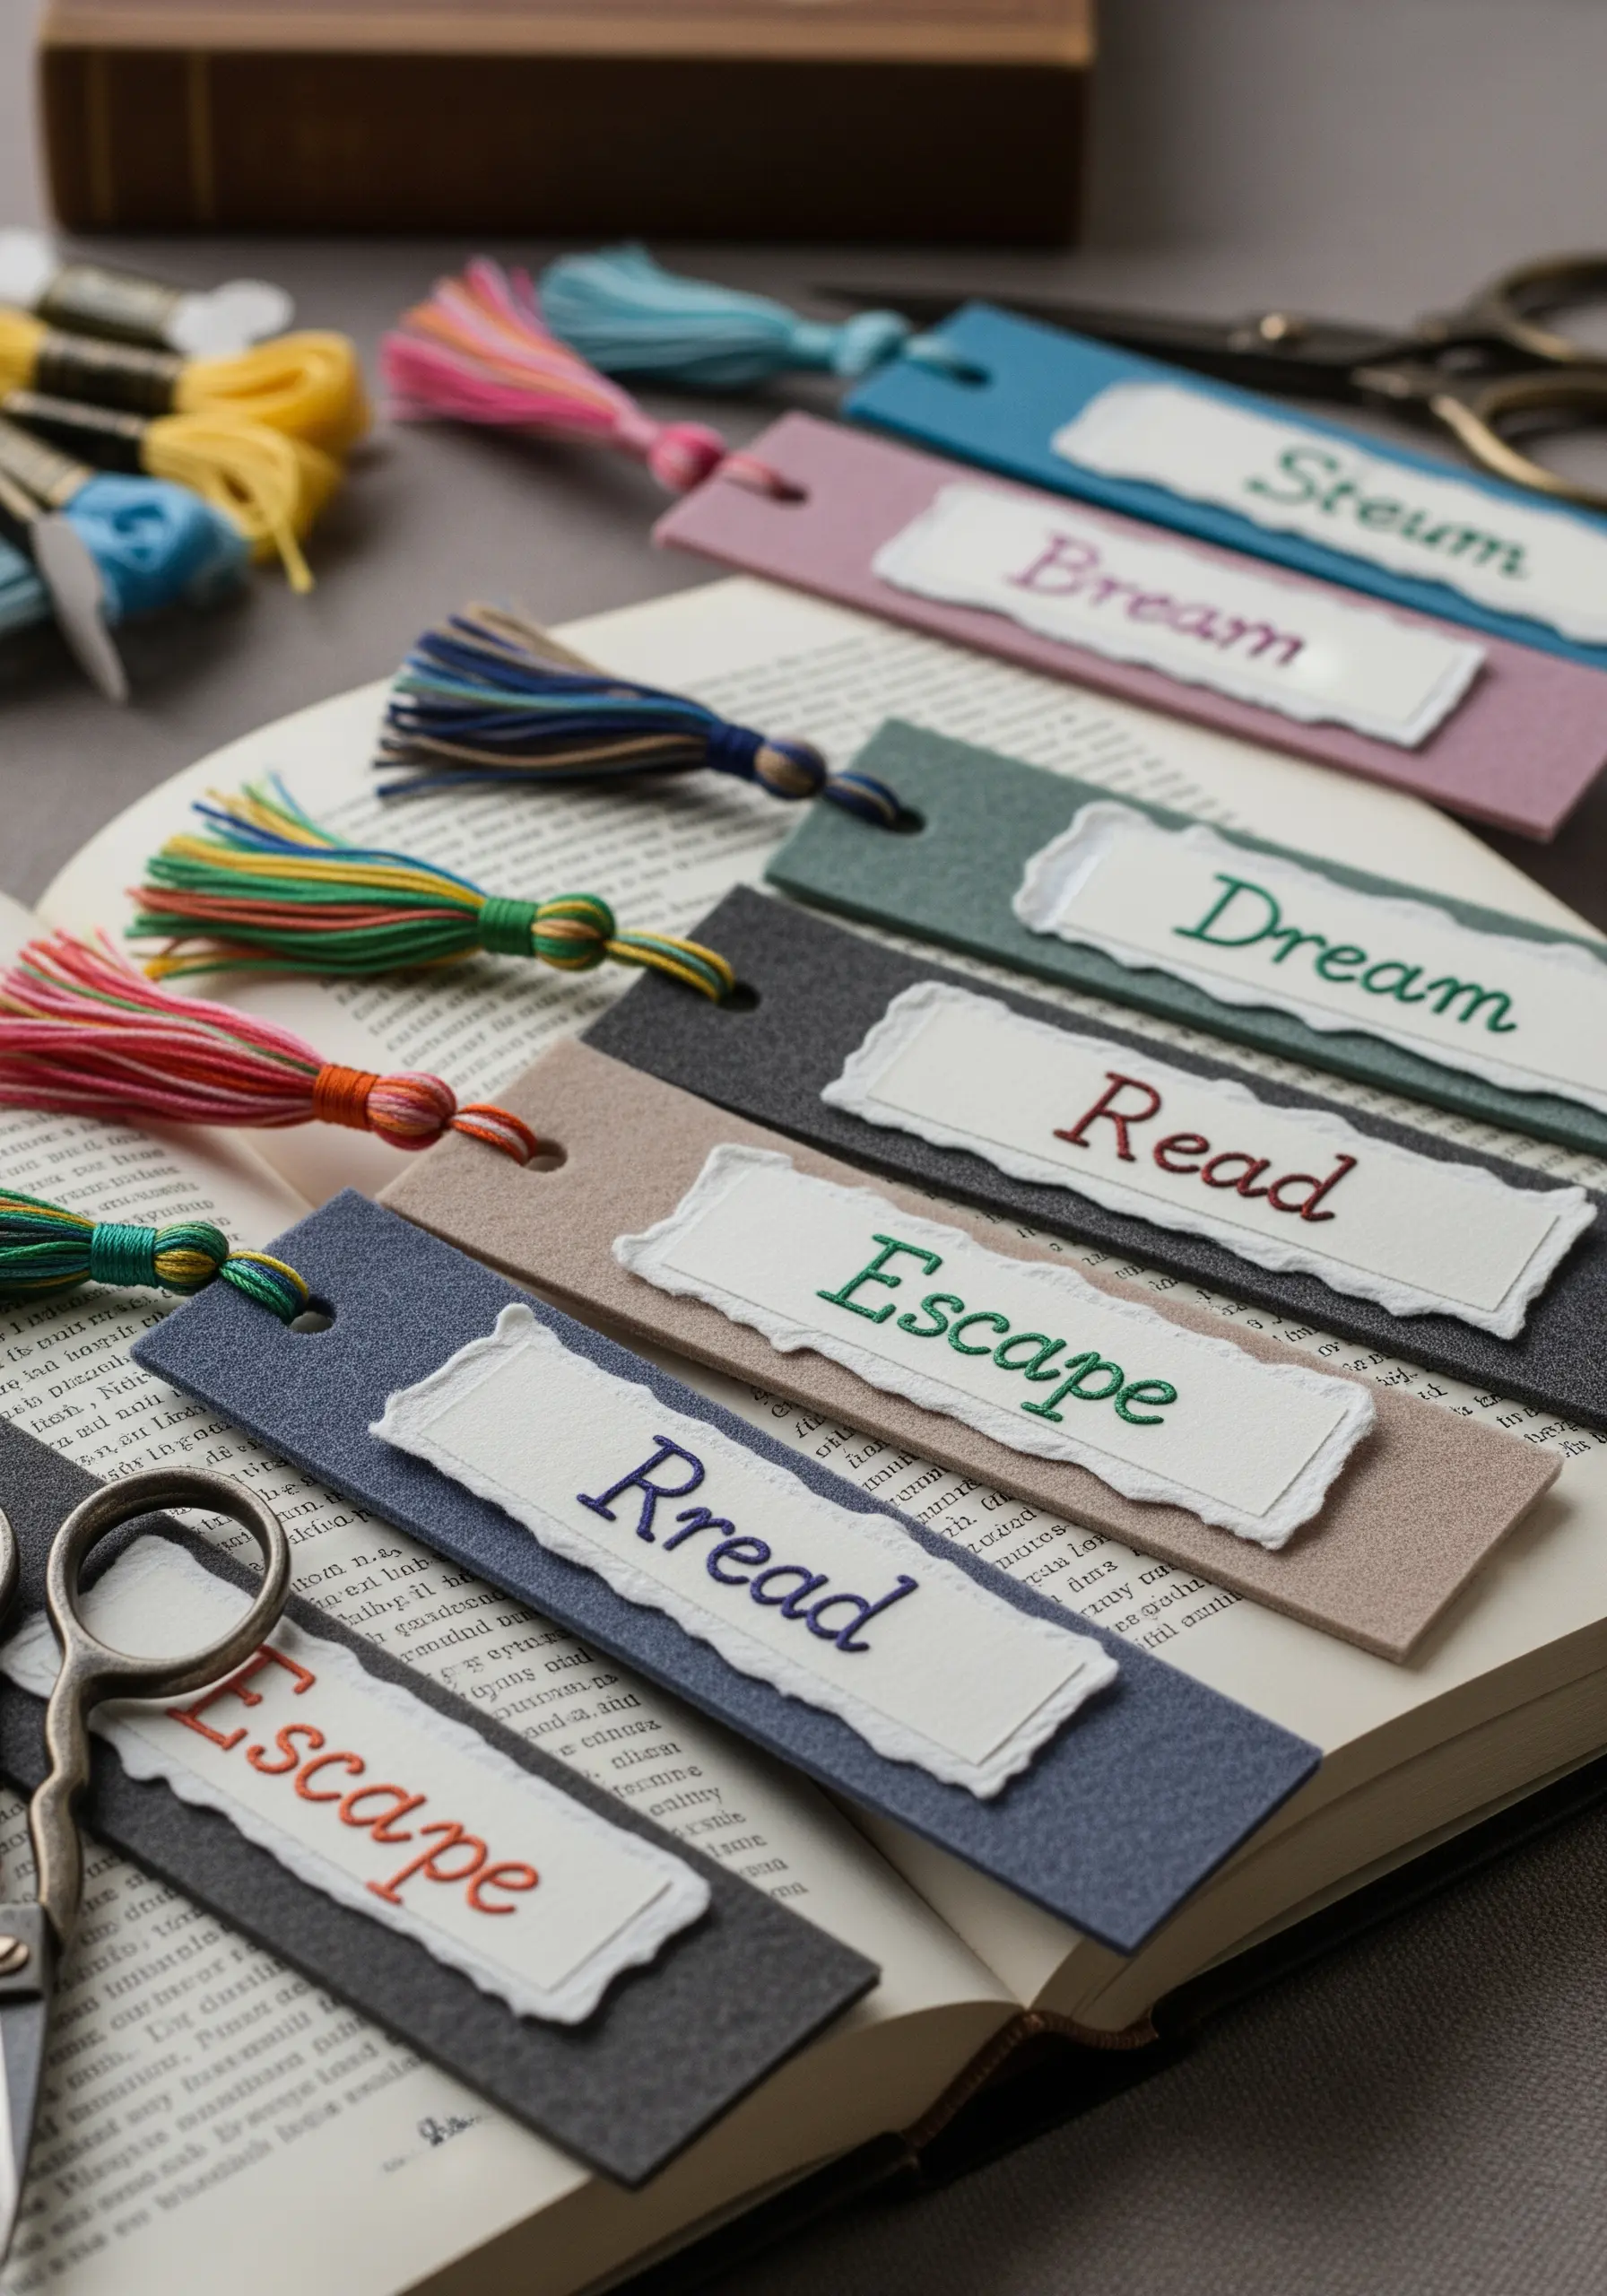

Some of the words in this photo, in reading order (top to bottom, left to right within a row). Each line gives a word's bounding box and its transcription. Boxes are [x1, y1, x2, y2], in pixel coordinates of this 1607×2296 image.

[1006, 527, 1305, 667] Bream
[1174, 874, 1518, 1034] Dream
[1054, 1071, 1358, 1222] Read
[815, 1232, 1178, 1426] Escape
[576, 1434, 919, 1651] Rread
[167, 1643, 540, 1916] Escape
